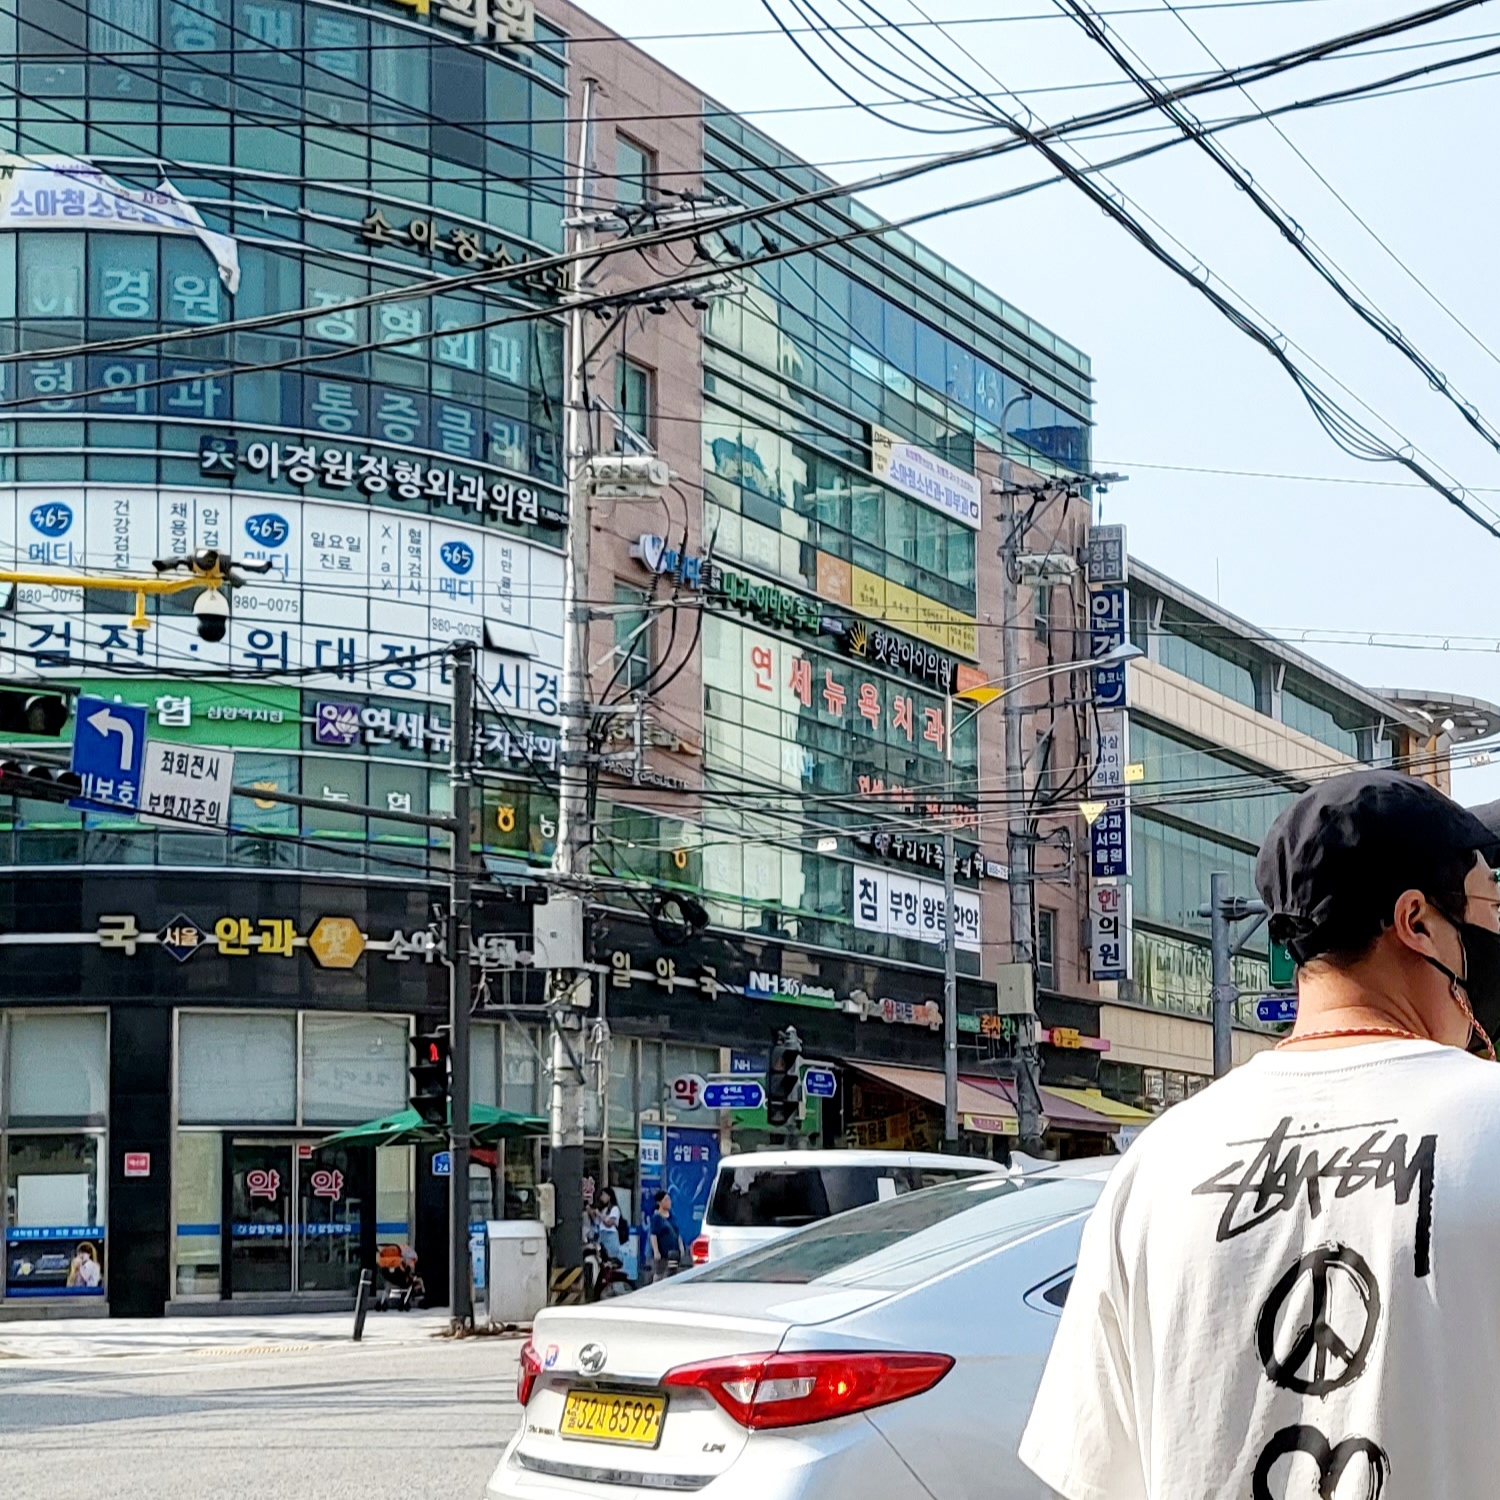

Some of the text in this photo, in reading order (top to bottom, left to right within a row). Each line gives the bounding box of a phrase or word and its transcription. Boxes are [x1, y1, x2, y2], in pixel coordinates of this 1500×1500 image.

[247, 442, 540, 525] 이경원정형외과의원
[31, 508, 71, 530] 365
[170, 502, 188, 561] 채용검
[249, 518, 288, 540] 365
[113, 500, 131, 570] 건강검진
[310, 531, 362, 552] 일요일
[29, 542, 73, 567] 메디
[319, 553, 353, 572] 진료
[442, 542, 474, 568] 365
[18, 588, 83, 603] 980-0075
[233, 595, 300, 613] 980-0075
[439, 576, 475, 604] 메디
[432, 617, 482, 639] 980-0075
[874, 631, 952, 687] 햇살아이의원
[750, 645, 946, 753] 연세뉴욕치과
[160, 750, 221, 782] 좌회전시
[148, 793, 222, 825] 보행자주의
[1103, 866, 1116, 876] 5F
[858, 877, 878, 922] 침
[889, 889, 919, 926] 부항
[164, 926, 199, 947] 서울
[214, 917, 297, 958] 안과
[1096, 889, 1120, 968] 한의원
[749, 970, 779, 994] NH
[733, 1058, 751, 1071] NH
[673, 1078, 699, 1106] 약
[437, 1163, 450, 1173] 24
[247, 1169, 345, 1202] 약 약
[608, 1399, 656, 1436] 8599
